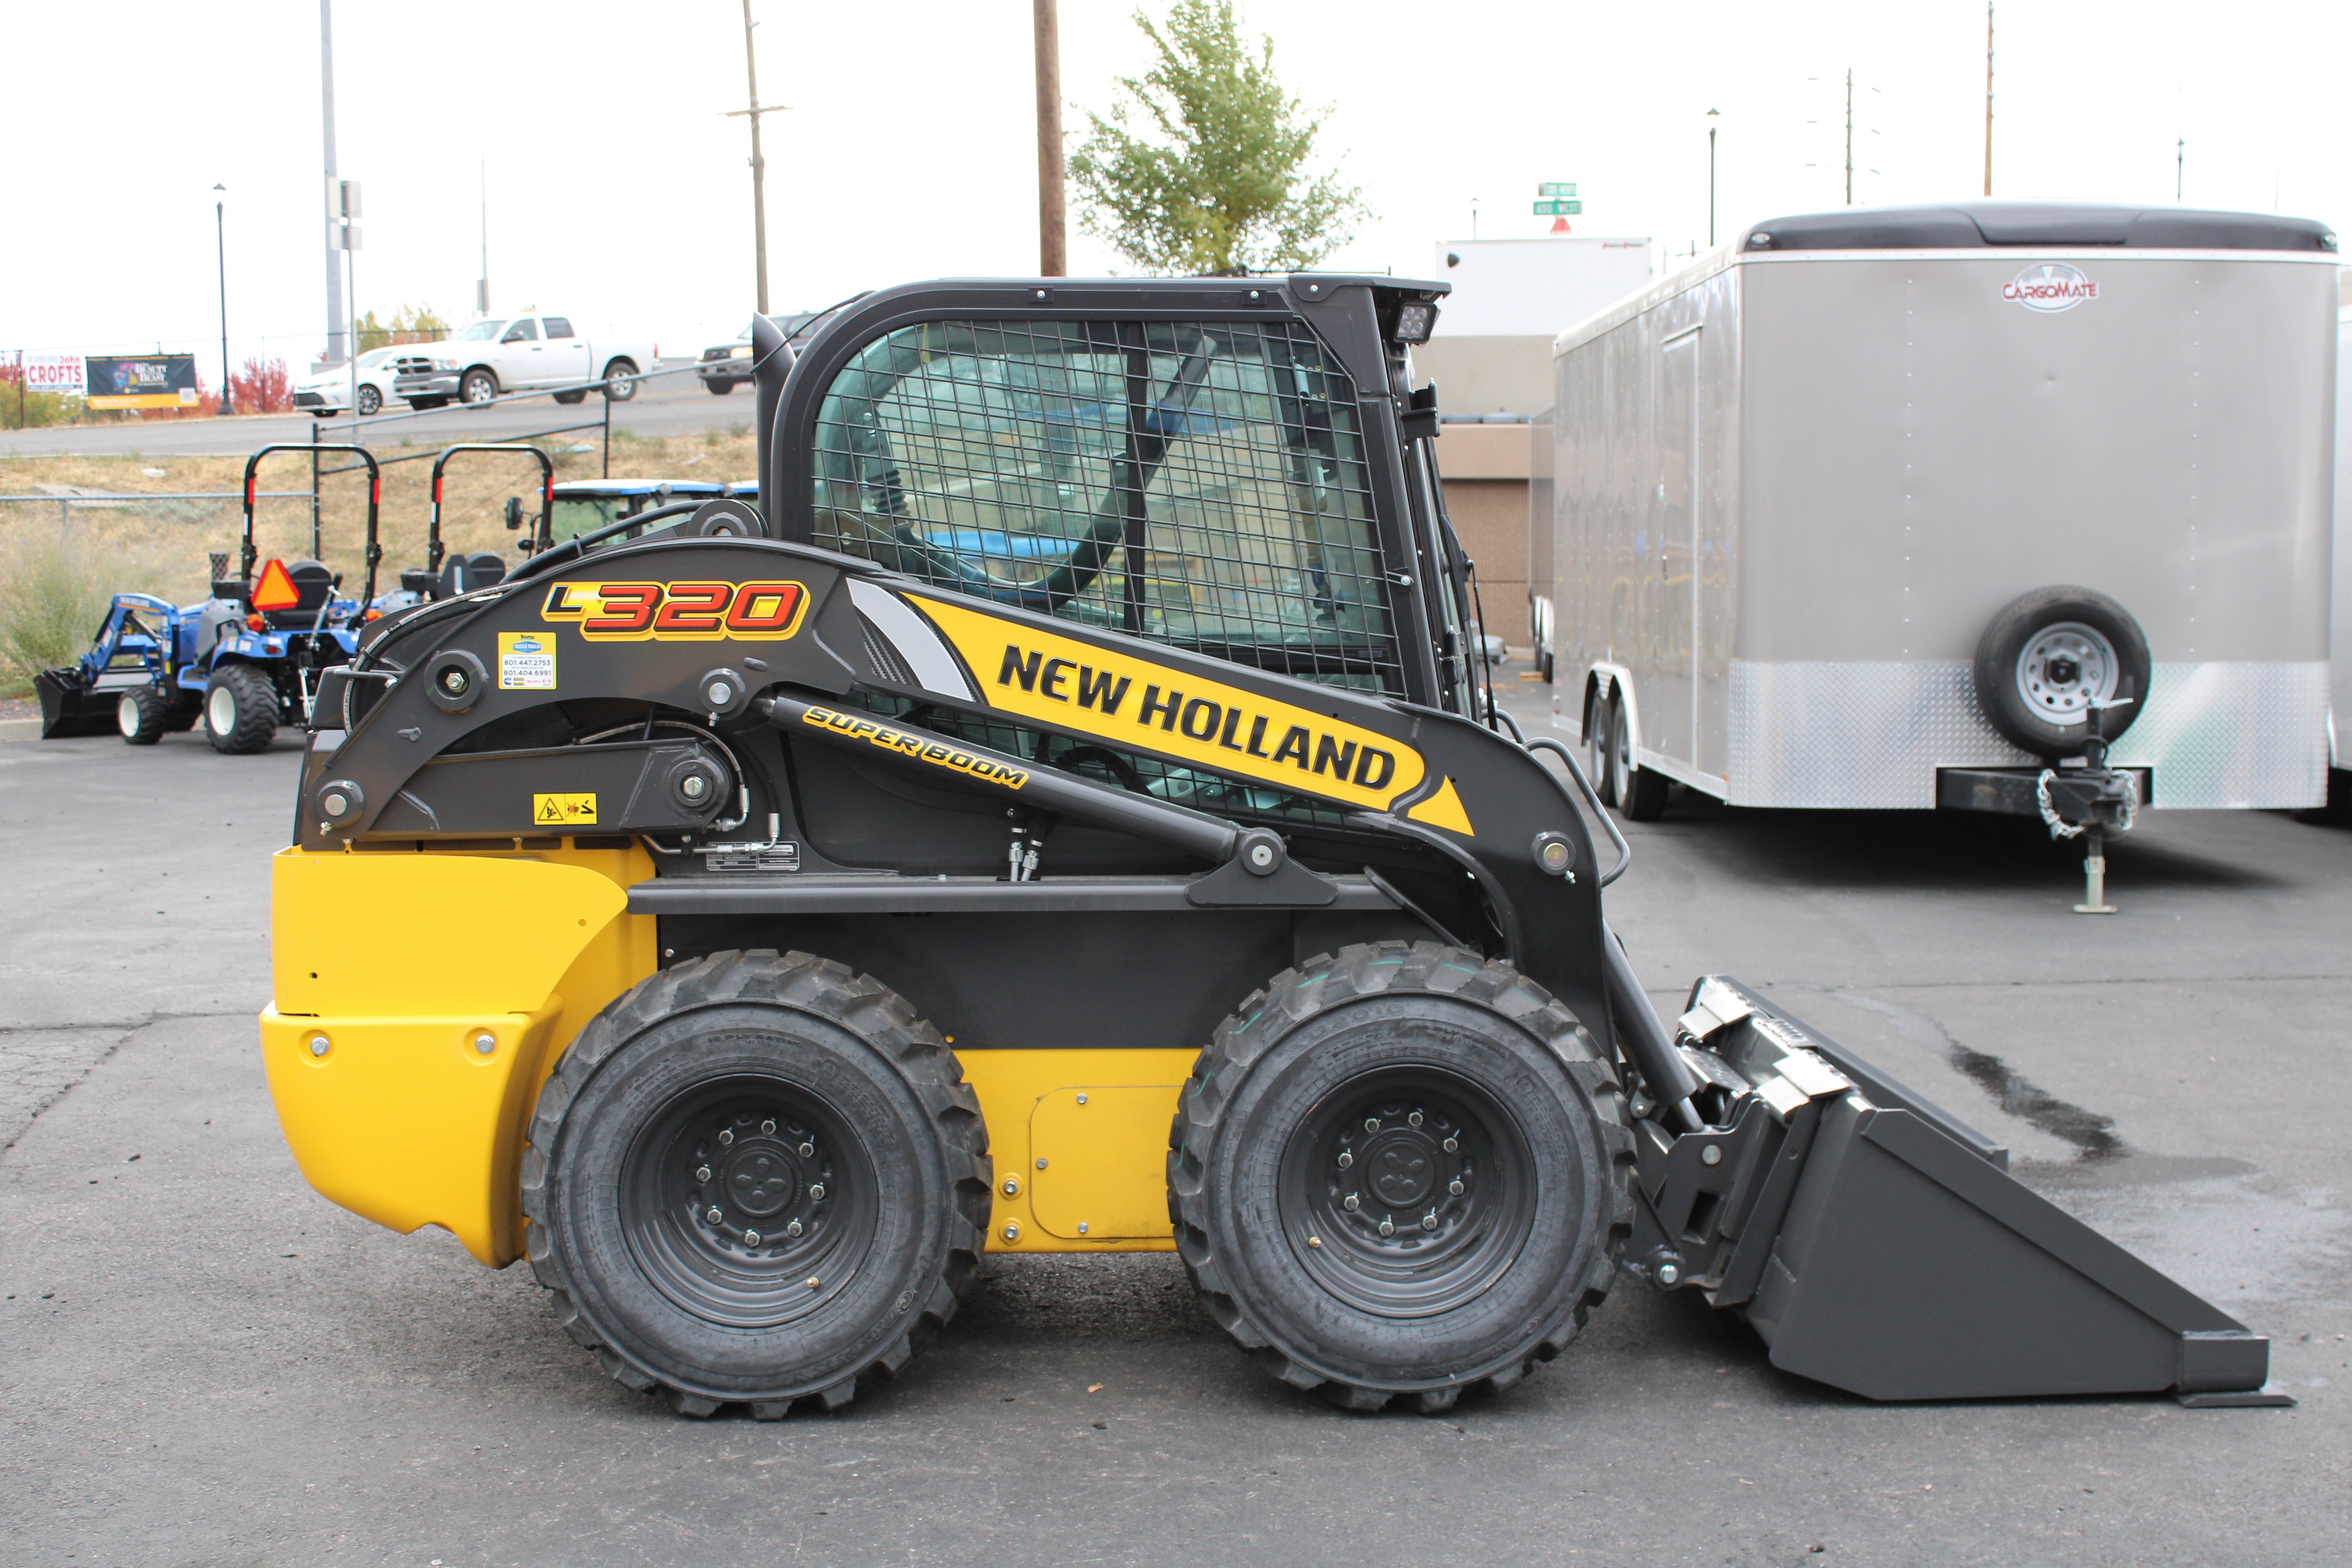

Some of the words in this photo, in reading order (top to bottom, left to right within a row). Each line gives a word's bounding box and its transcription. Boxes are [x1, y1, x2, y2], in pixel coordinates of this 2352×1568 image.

[1537, 203, 1553, 213] 650
[1558, 203, 1577, 213] WEST
[29, 365, 82, 383] CROFTS
[546, 585, 805, 632] L320
[997, 643, 1132, 717] NEW
[1138, 683, 1395, 791] HOLLAND
[804, 706, 922, 753] SUPER
[924, 744, 1027, 787] BOOM
[755, 1034, 803, 1049] RATING
[1285, 1002, 1405, 1059] XD2010
[588, 1020, 695, 1104] XD2010
